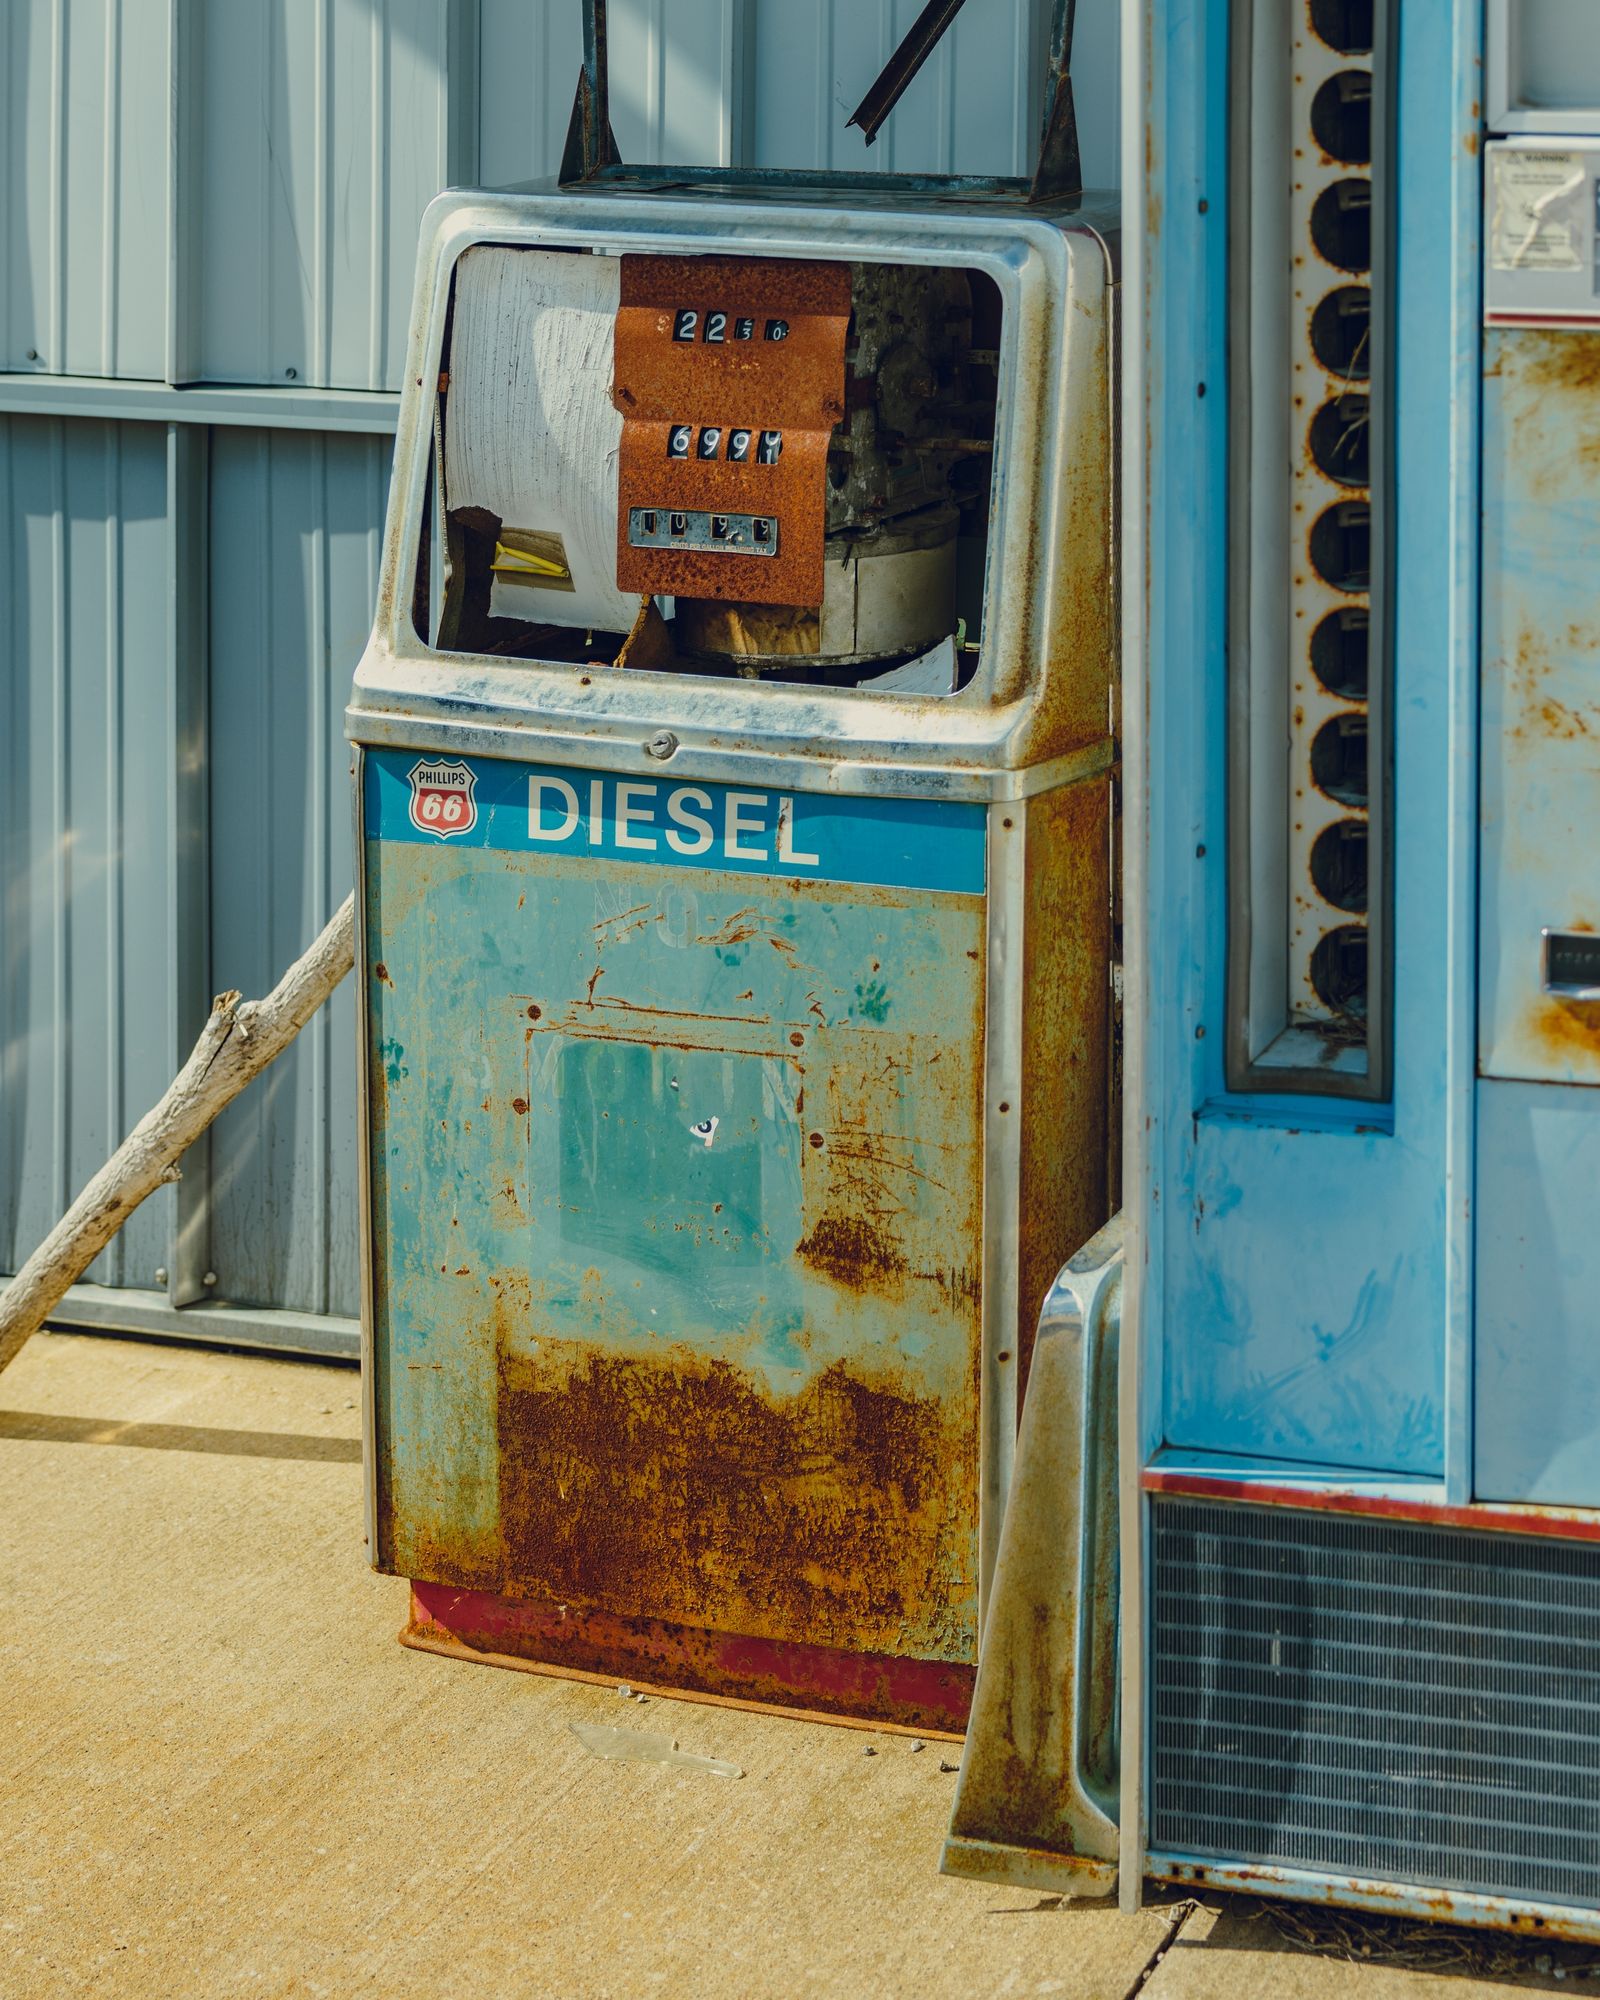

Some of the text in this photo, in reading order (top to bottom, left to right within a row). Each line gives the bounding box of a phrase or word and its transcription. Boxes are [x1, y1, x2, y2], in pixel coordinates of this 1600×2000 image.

[419, 771, 465, 785] PHILLIPS
[422, 793, 464, 822] 66
[528, 775, 819, 866] DIESEL
